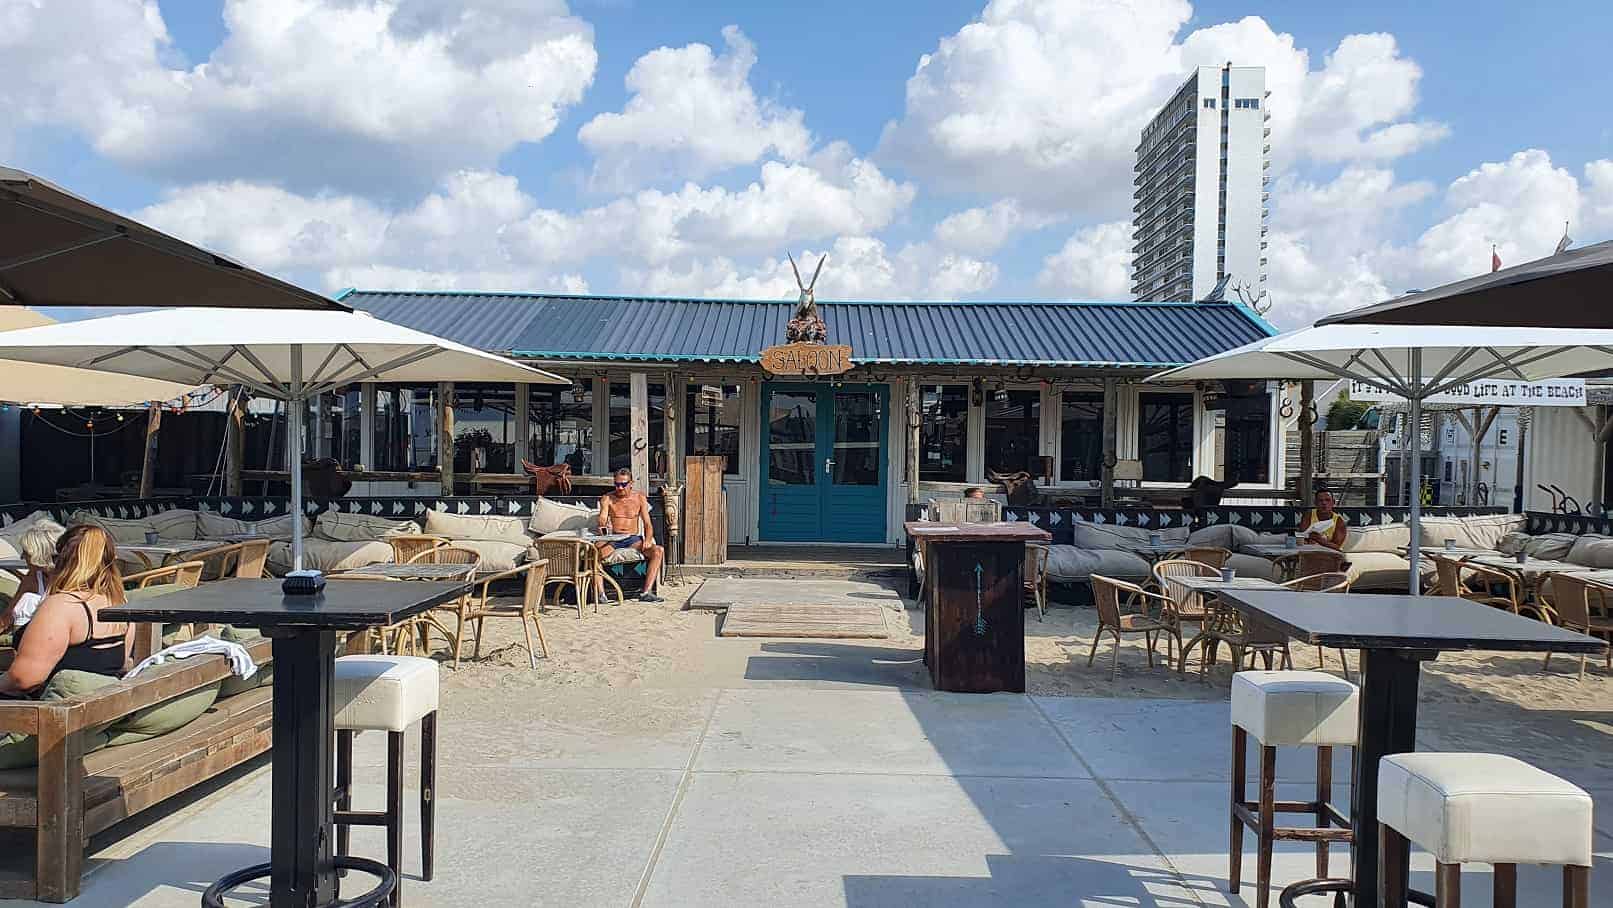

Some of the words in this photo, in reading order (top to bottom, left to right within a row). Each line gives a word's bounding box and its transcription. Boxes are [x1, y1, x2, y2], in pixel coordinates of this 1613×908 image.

[772, 349, 842, 370] SALOON
[1502, 385, 1516, 397] AT
[1521, 385, 1544, 398] THE
[1547, 386, 1583, 399] BEACH
